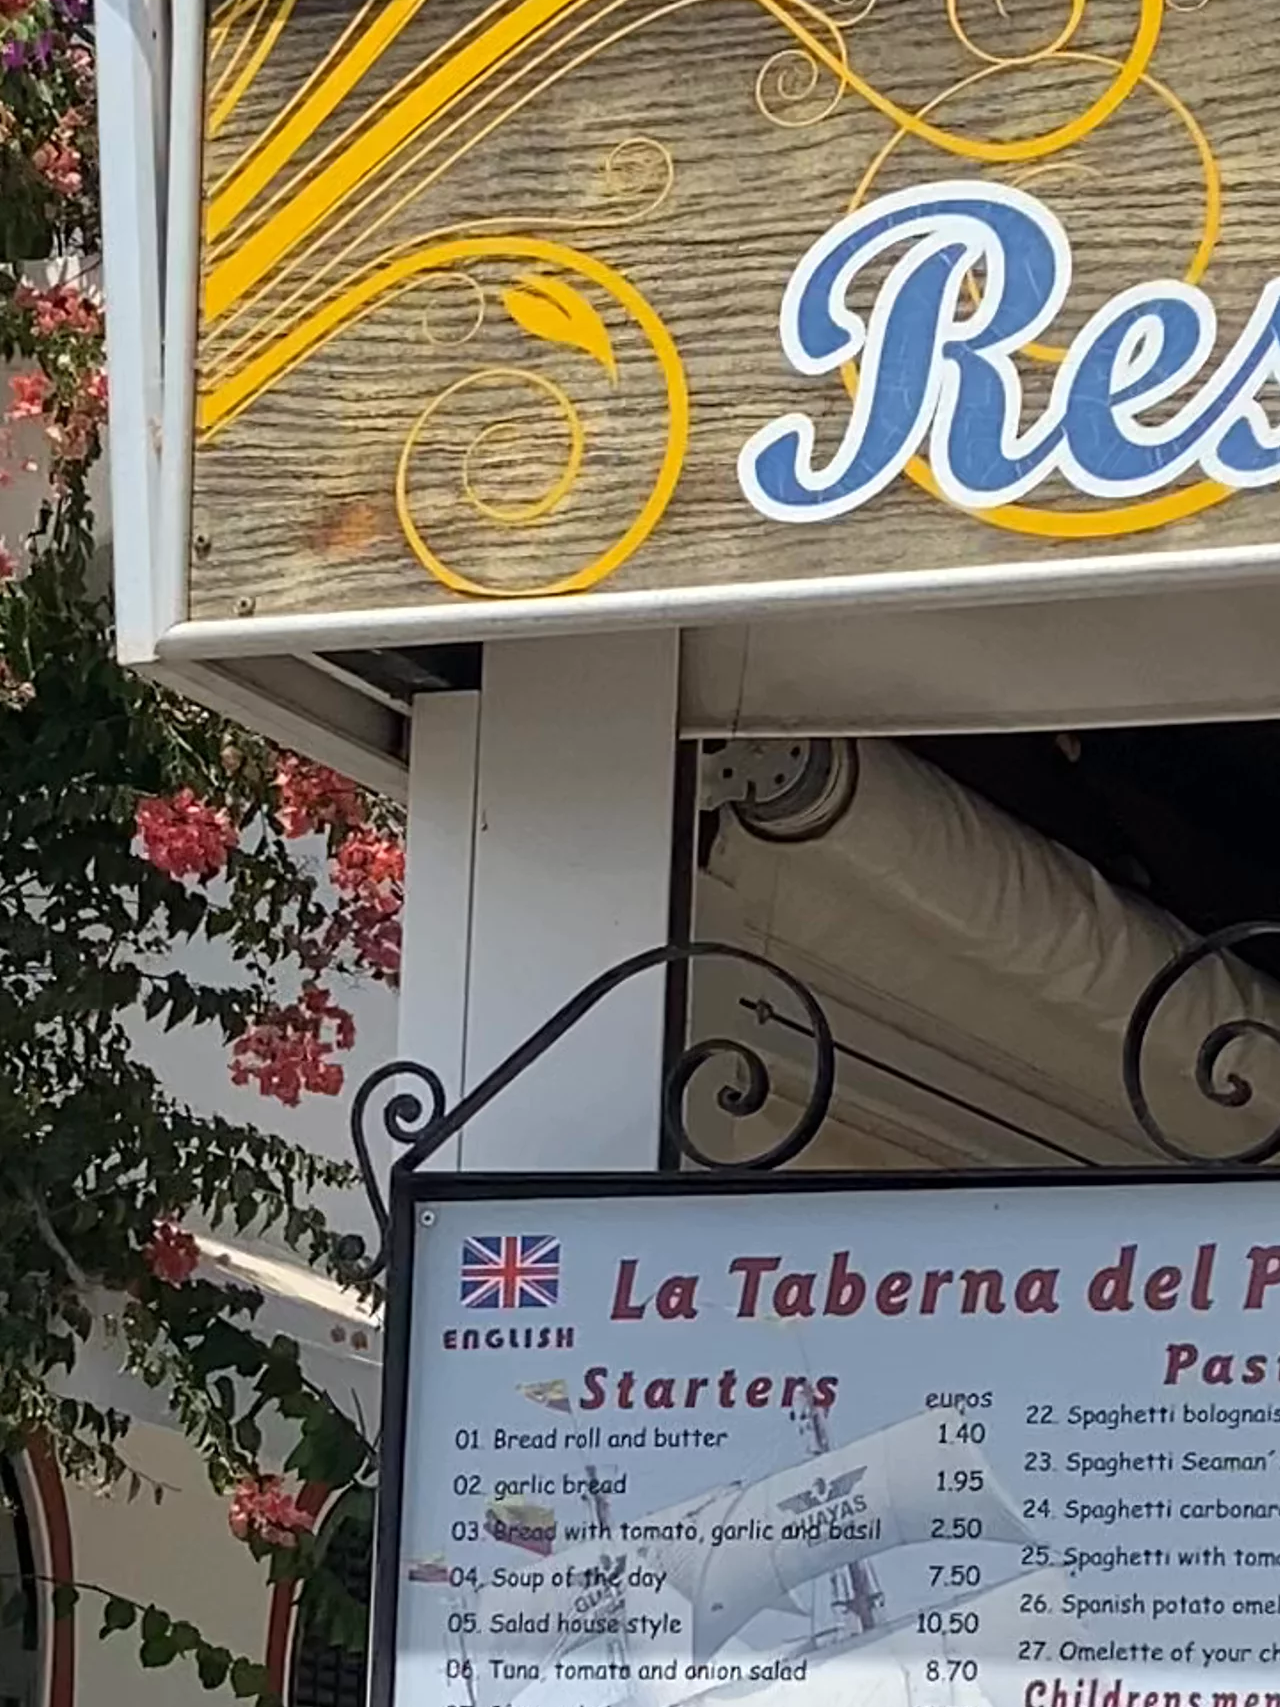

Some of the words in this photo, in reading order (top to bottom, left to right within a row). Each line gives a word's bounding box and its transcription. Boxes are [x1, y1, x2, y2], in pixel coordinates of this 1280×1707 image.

[610, 1257, 700, 1322] La
[728, 1250, 1060, 1320] Taberna
[1087, 1242, 1217, 1313] del
[442, 1328, 575, 1350] ENGLISH
[580, 1366, 840, 1412] Starters
[494, 1428, 558, 1450] Bread
[564, 1428, 601, 1450] roll
[609, 1429, 647, 1449] and
[653, 1428, 729, 1450] butter
[937, 1424, 986, 1445] 1.40
[1061, 1595, 1145, 1619] Spanish
[1152, 1597, 1223, 1620] potato
